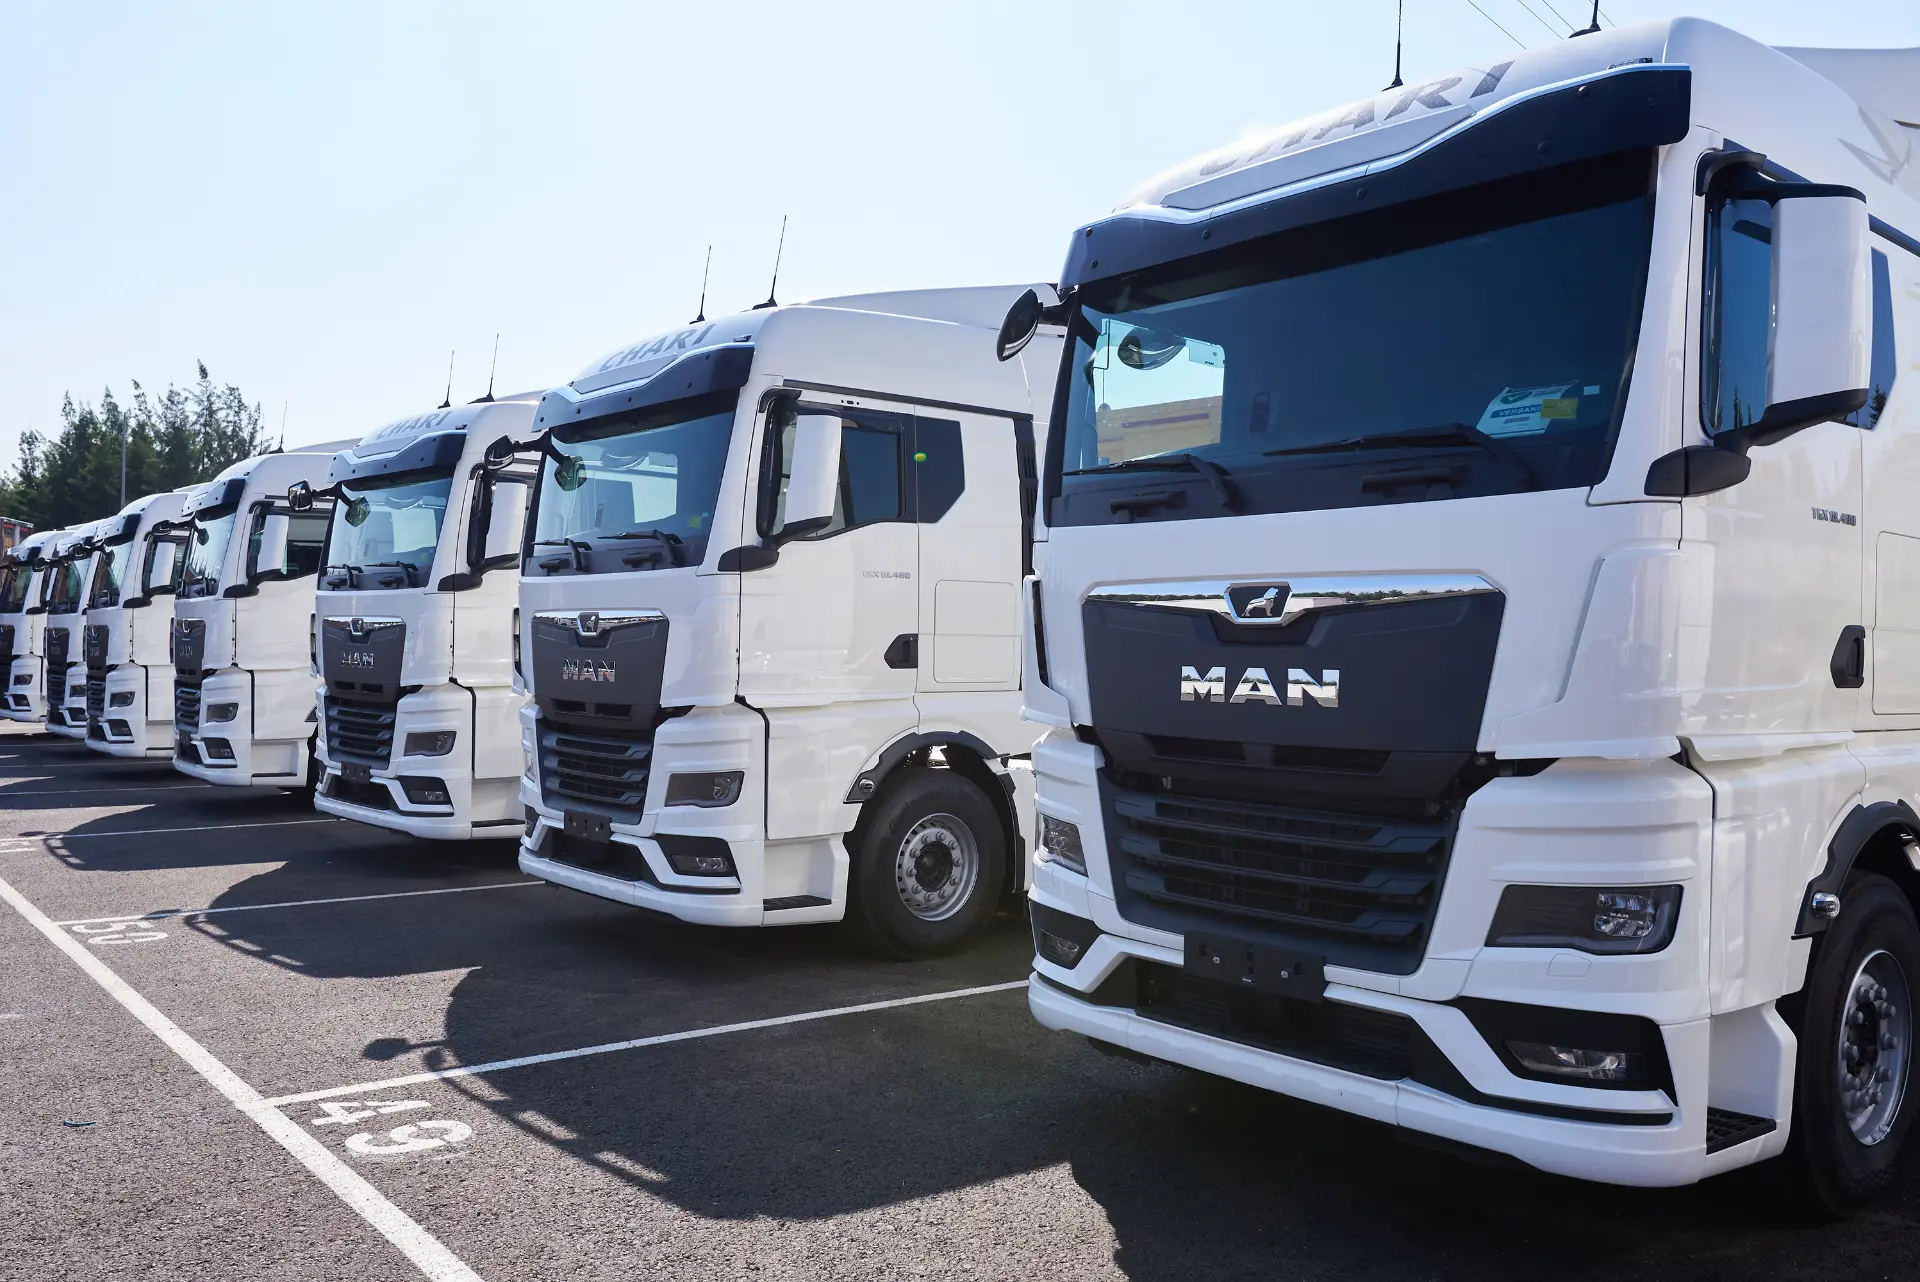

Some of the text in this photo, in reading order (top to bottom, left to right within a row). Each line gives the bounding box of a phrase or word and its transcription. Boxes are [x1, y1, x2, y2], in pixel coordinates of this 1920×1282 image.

[598, 323, 717, 373] CHARI
[376, 410, 453, 440] CHARI
[340, 651, 374, 669] MAN
[562, 658, 616, 683] MAN
[1180, 665, 1340, 708] MAN
[71, 920, 169, 945] 50
[310, 1099, 473, 1155] 49
